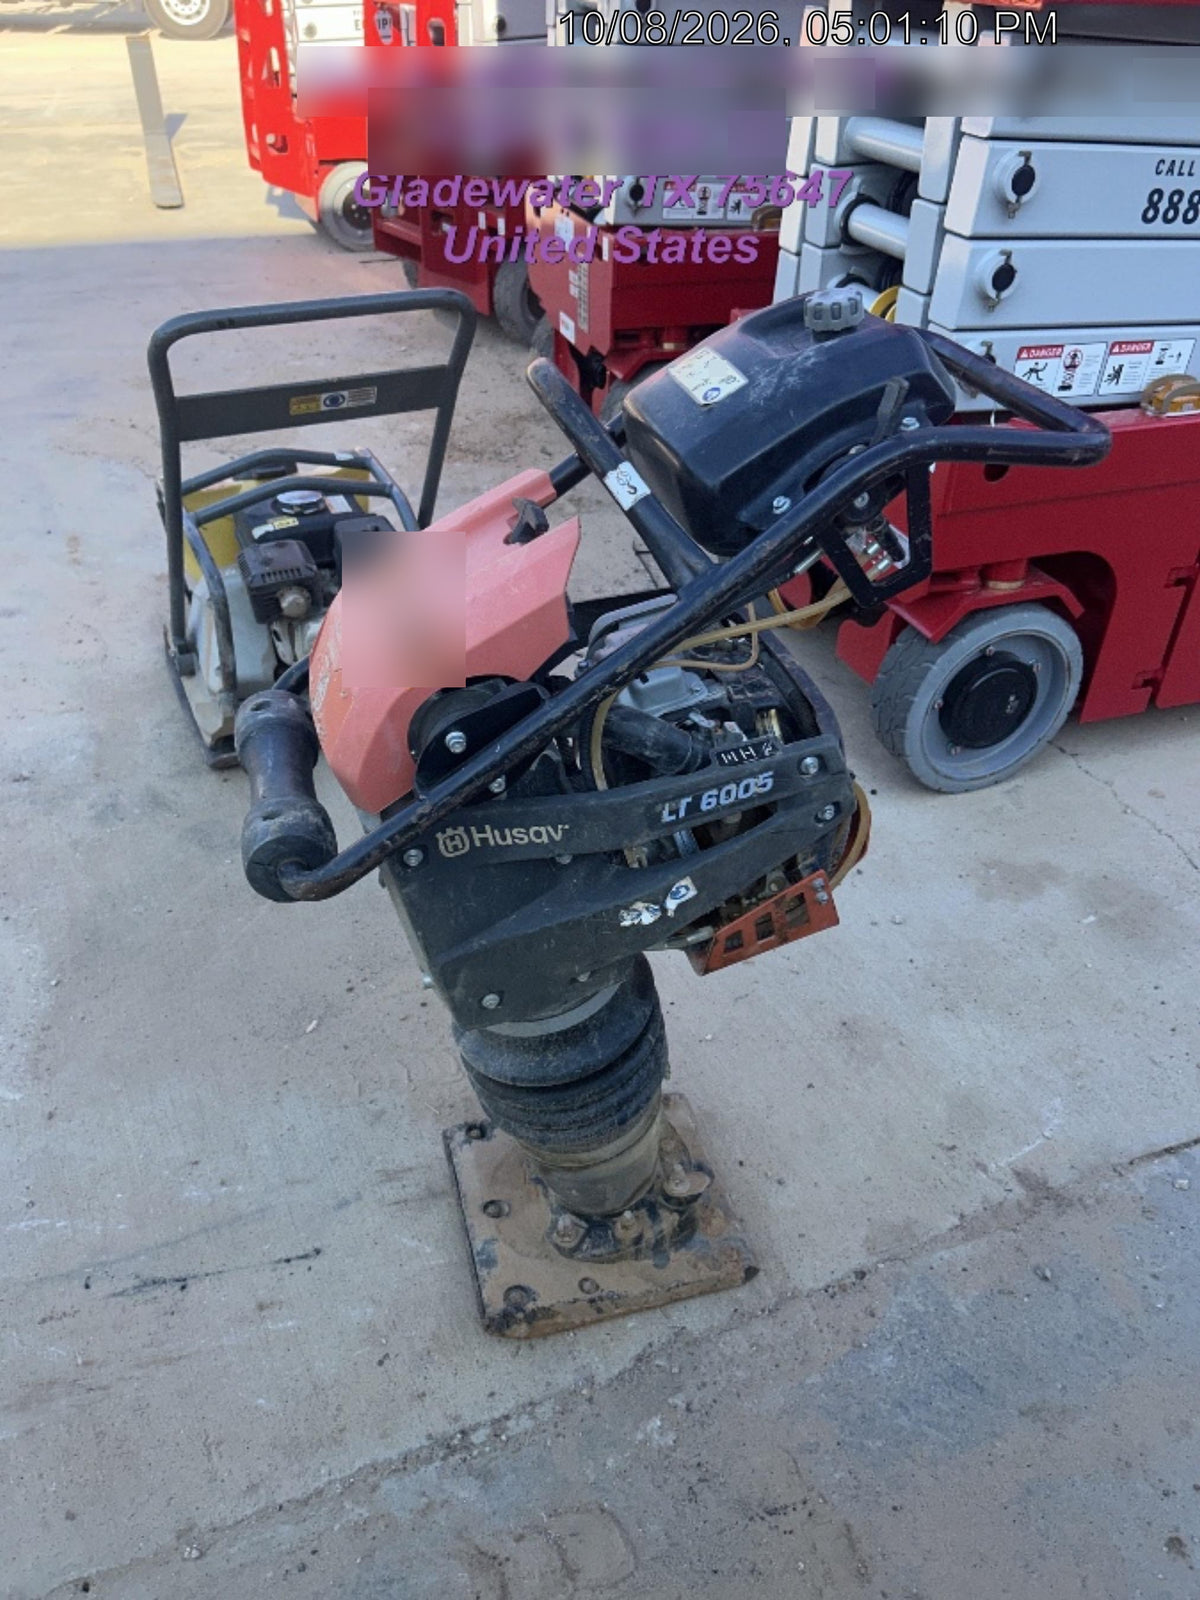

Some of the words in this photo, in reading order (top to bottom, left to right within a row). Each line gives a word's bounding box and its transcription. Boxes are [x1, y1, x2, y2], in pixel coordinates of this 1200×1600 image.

[1155, 158, 1195, 177] CALL
[661, 797, 693, 823] LT
[700, 770, 775, 812] 6005
